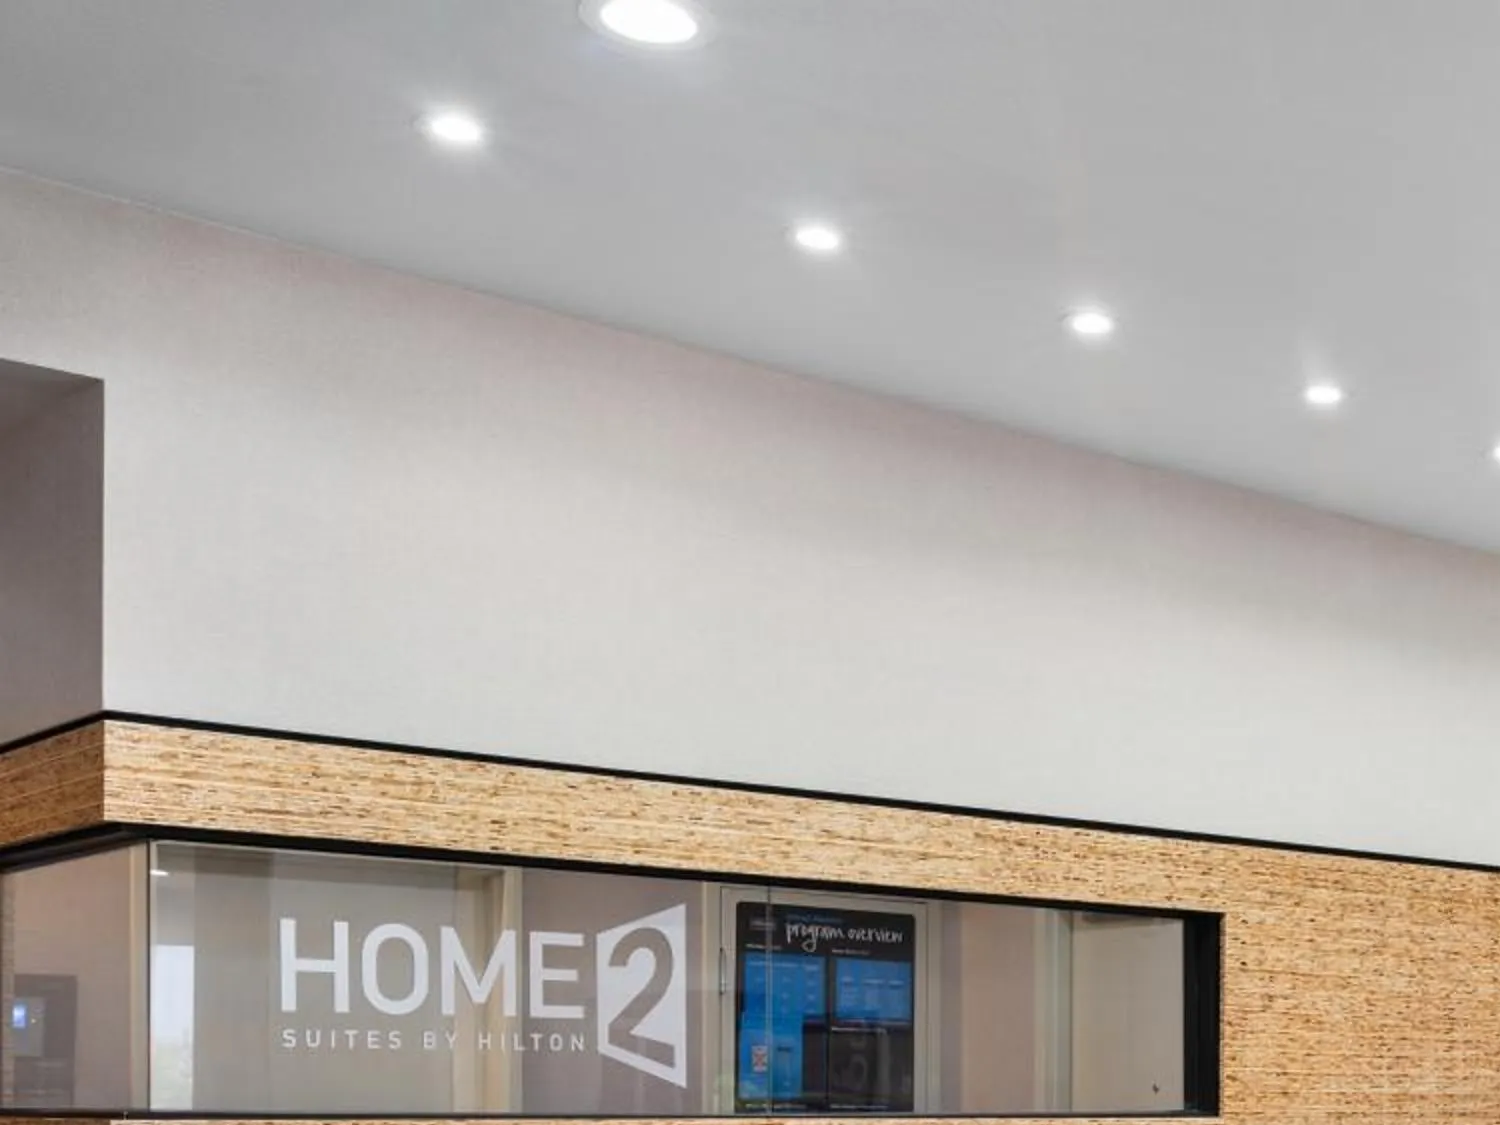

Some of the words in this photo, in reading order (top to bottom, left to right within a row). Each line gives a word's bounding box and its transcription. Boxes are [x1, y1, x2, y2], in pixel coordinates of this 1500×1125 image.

[785, 921, 844, 953] program
[847, 926, 904, 944] overview
[281, 1027, 403, 1050] SUITES
[423, 1030, 459, 1051] BY
[477, 1032, 586, 1053] HILTON
